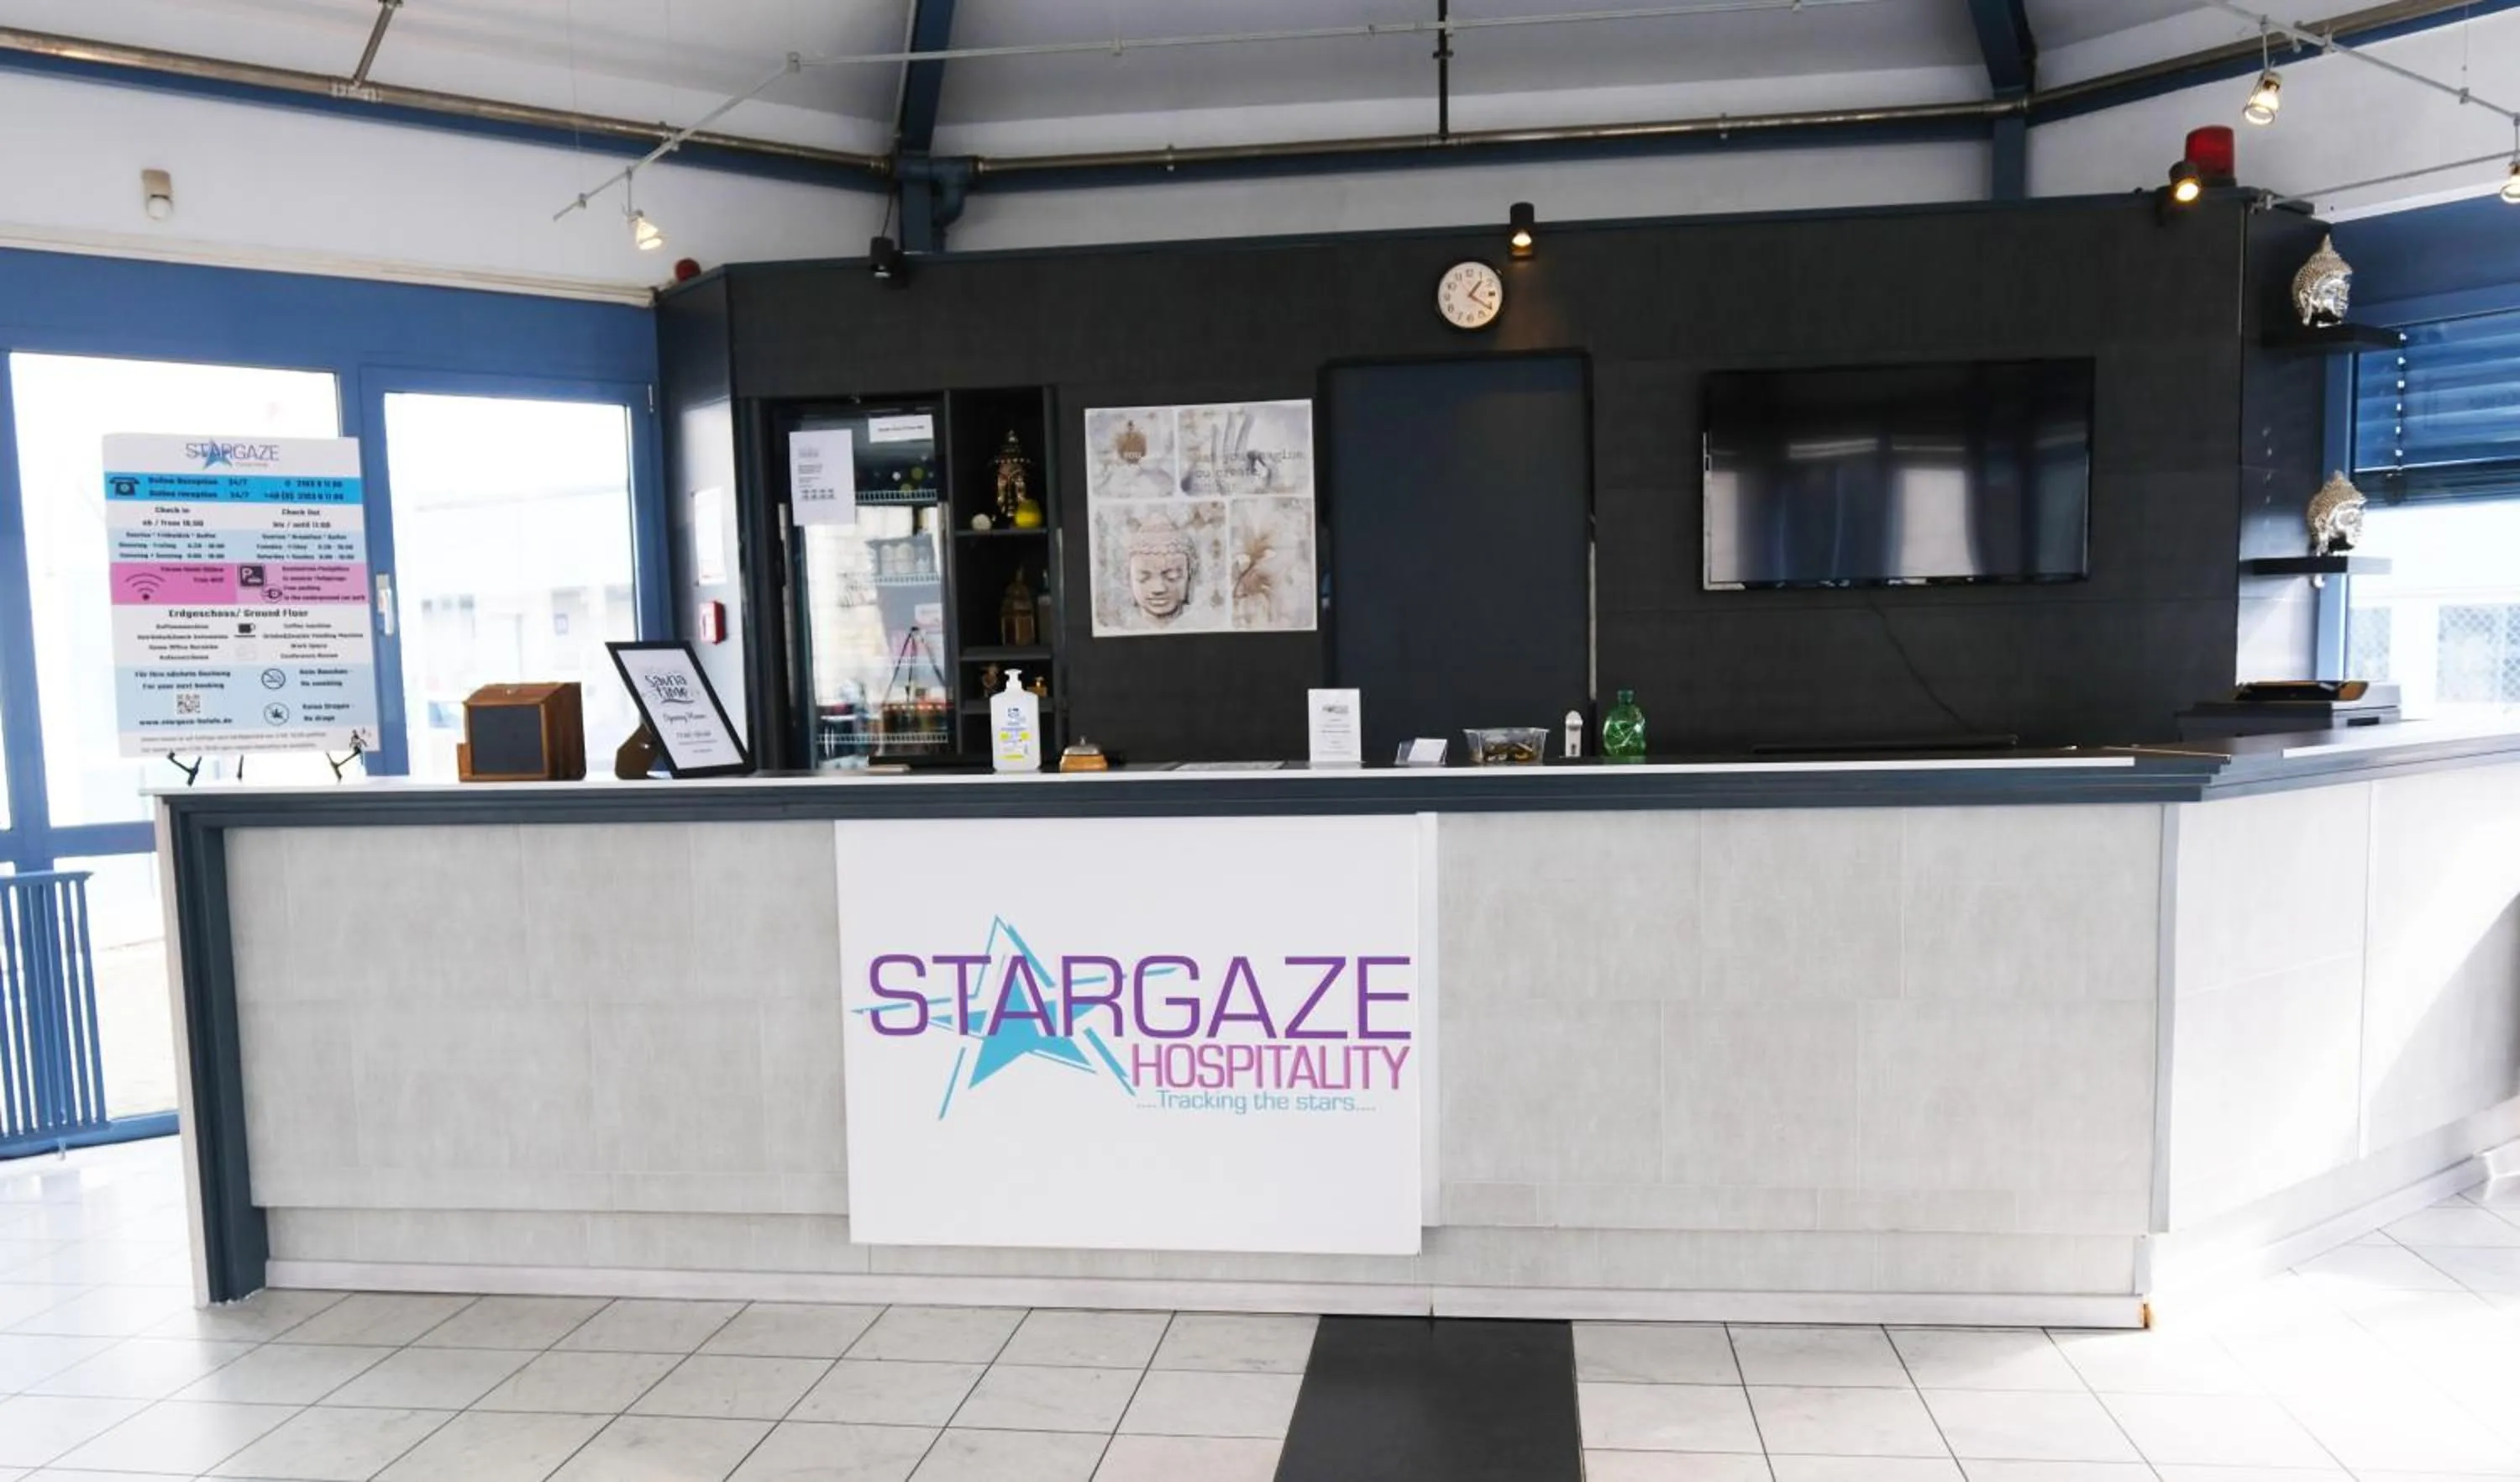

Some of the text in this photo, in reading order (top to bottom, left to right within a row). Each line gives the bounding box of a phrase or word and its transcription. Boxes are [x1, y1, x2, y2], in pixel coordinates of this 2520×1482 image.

[186, 443, 280, 461] STARGAZE
[242, 568, 253, 579] P
[869, 953, 1412, 1040] STARGAZE
[1131, 1043, 1411, 1090] HOSPITALITY
[1254, 1091, 1289, 1111] the
